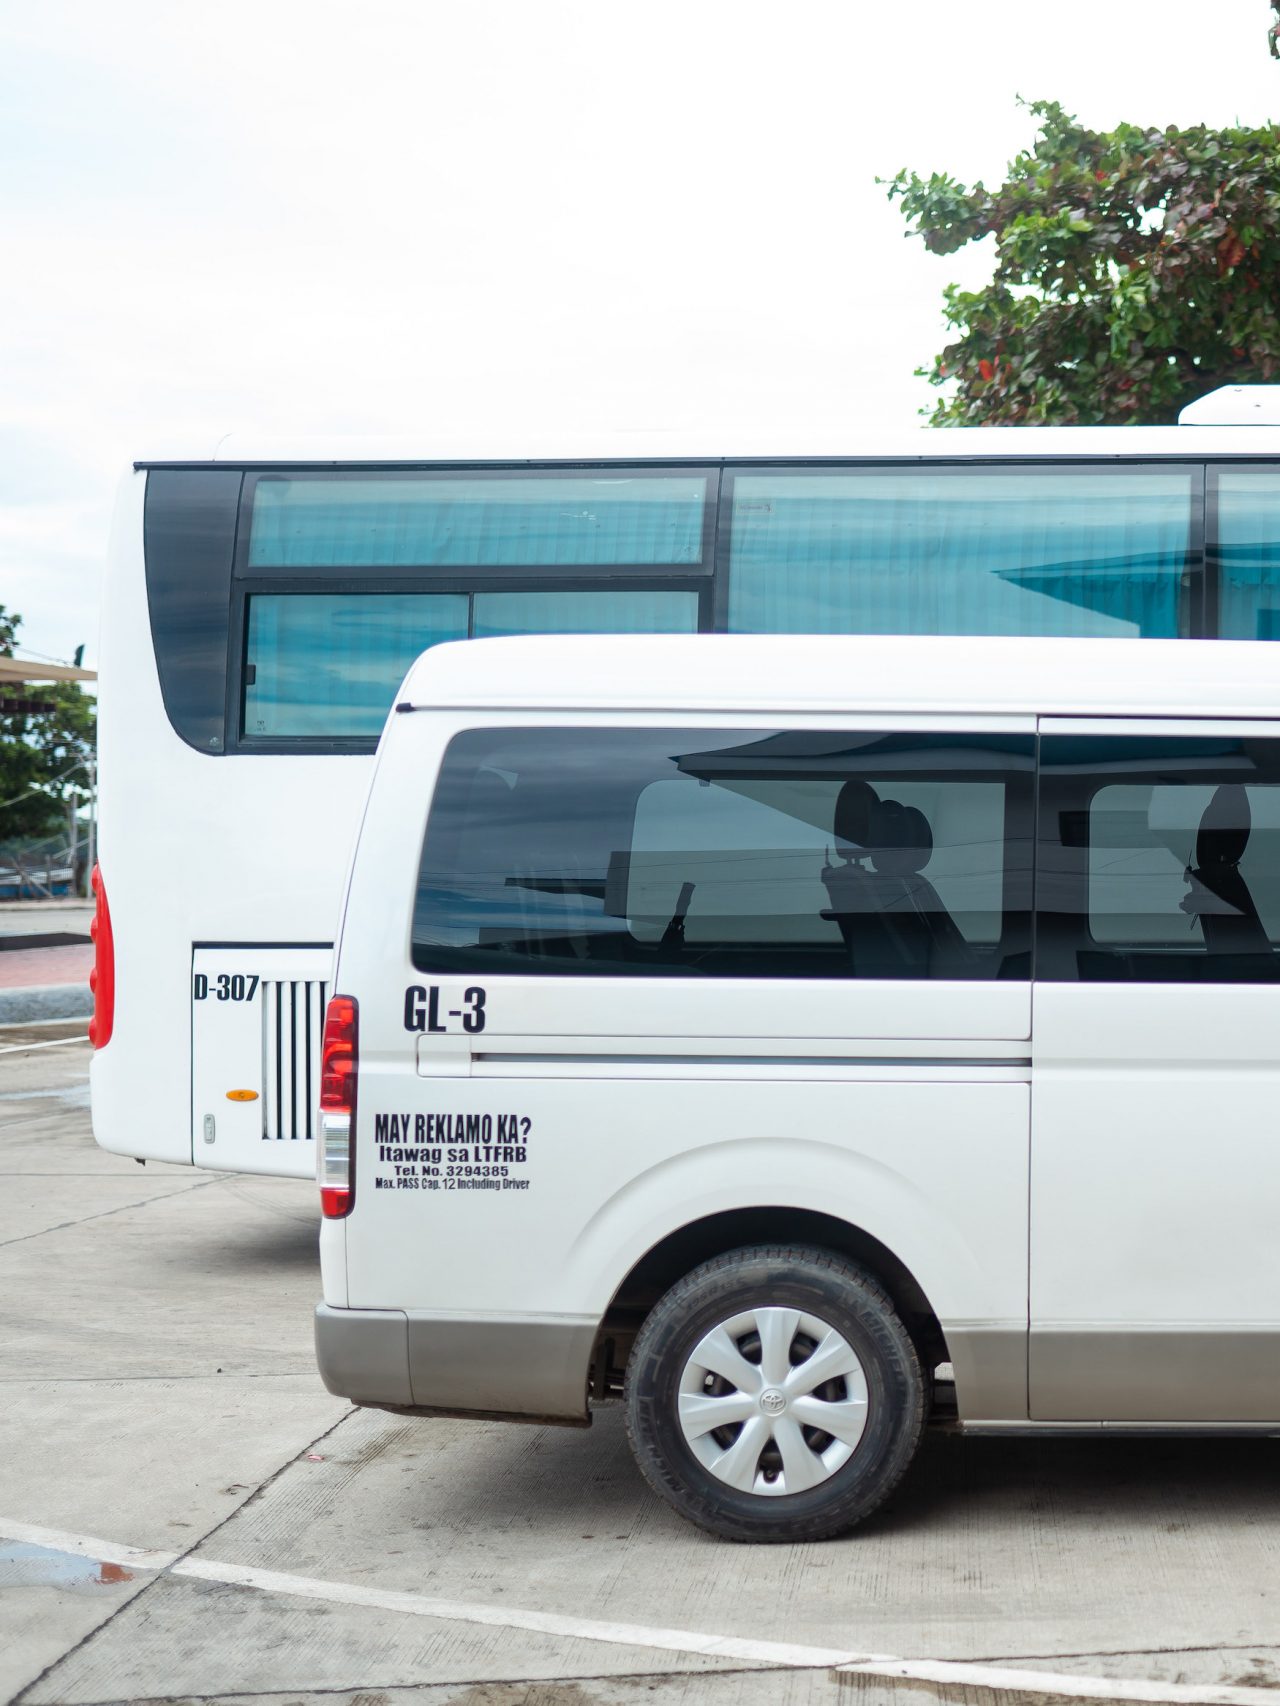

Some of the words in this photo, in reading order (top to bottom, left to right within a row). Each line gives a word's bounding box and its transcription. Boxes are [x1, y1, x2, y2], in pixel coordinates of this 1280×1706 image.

[194, 974, 259, 1001] D-307
[404, 985, 486, 1033] GL-3
[375, 1114, 410, 1143] MAY
[415, 1114, 492, 1144] REKLAMO
[497, 1115, 532, 1143] KA?
[380, 1146, 442, 1164] Itawag
[447, 1148, 469, 1162] sa
[474, 1146, 527, 1162] LTFRB
[395, 1166, 418, 1176] Tel.
[422, 1166, 443, 1176] No.
[446, 1166, 509, 1177] 3294385
[375, 1178, 395, 1189] Max.
[397, 1178, 419, 1189] PASS
[421, 1178, 441, 1190] Cap.
[443, 1178, 456, 1189] 12
[457, 1178, 501, 1191] Including
[502, 1178, 530, 1190] Driver
